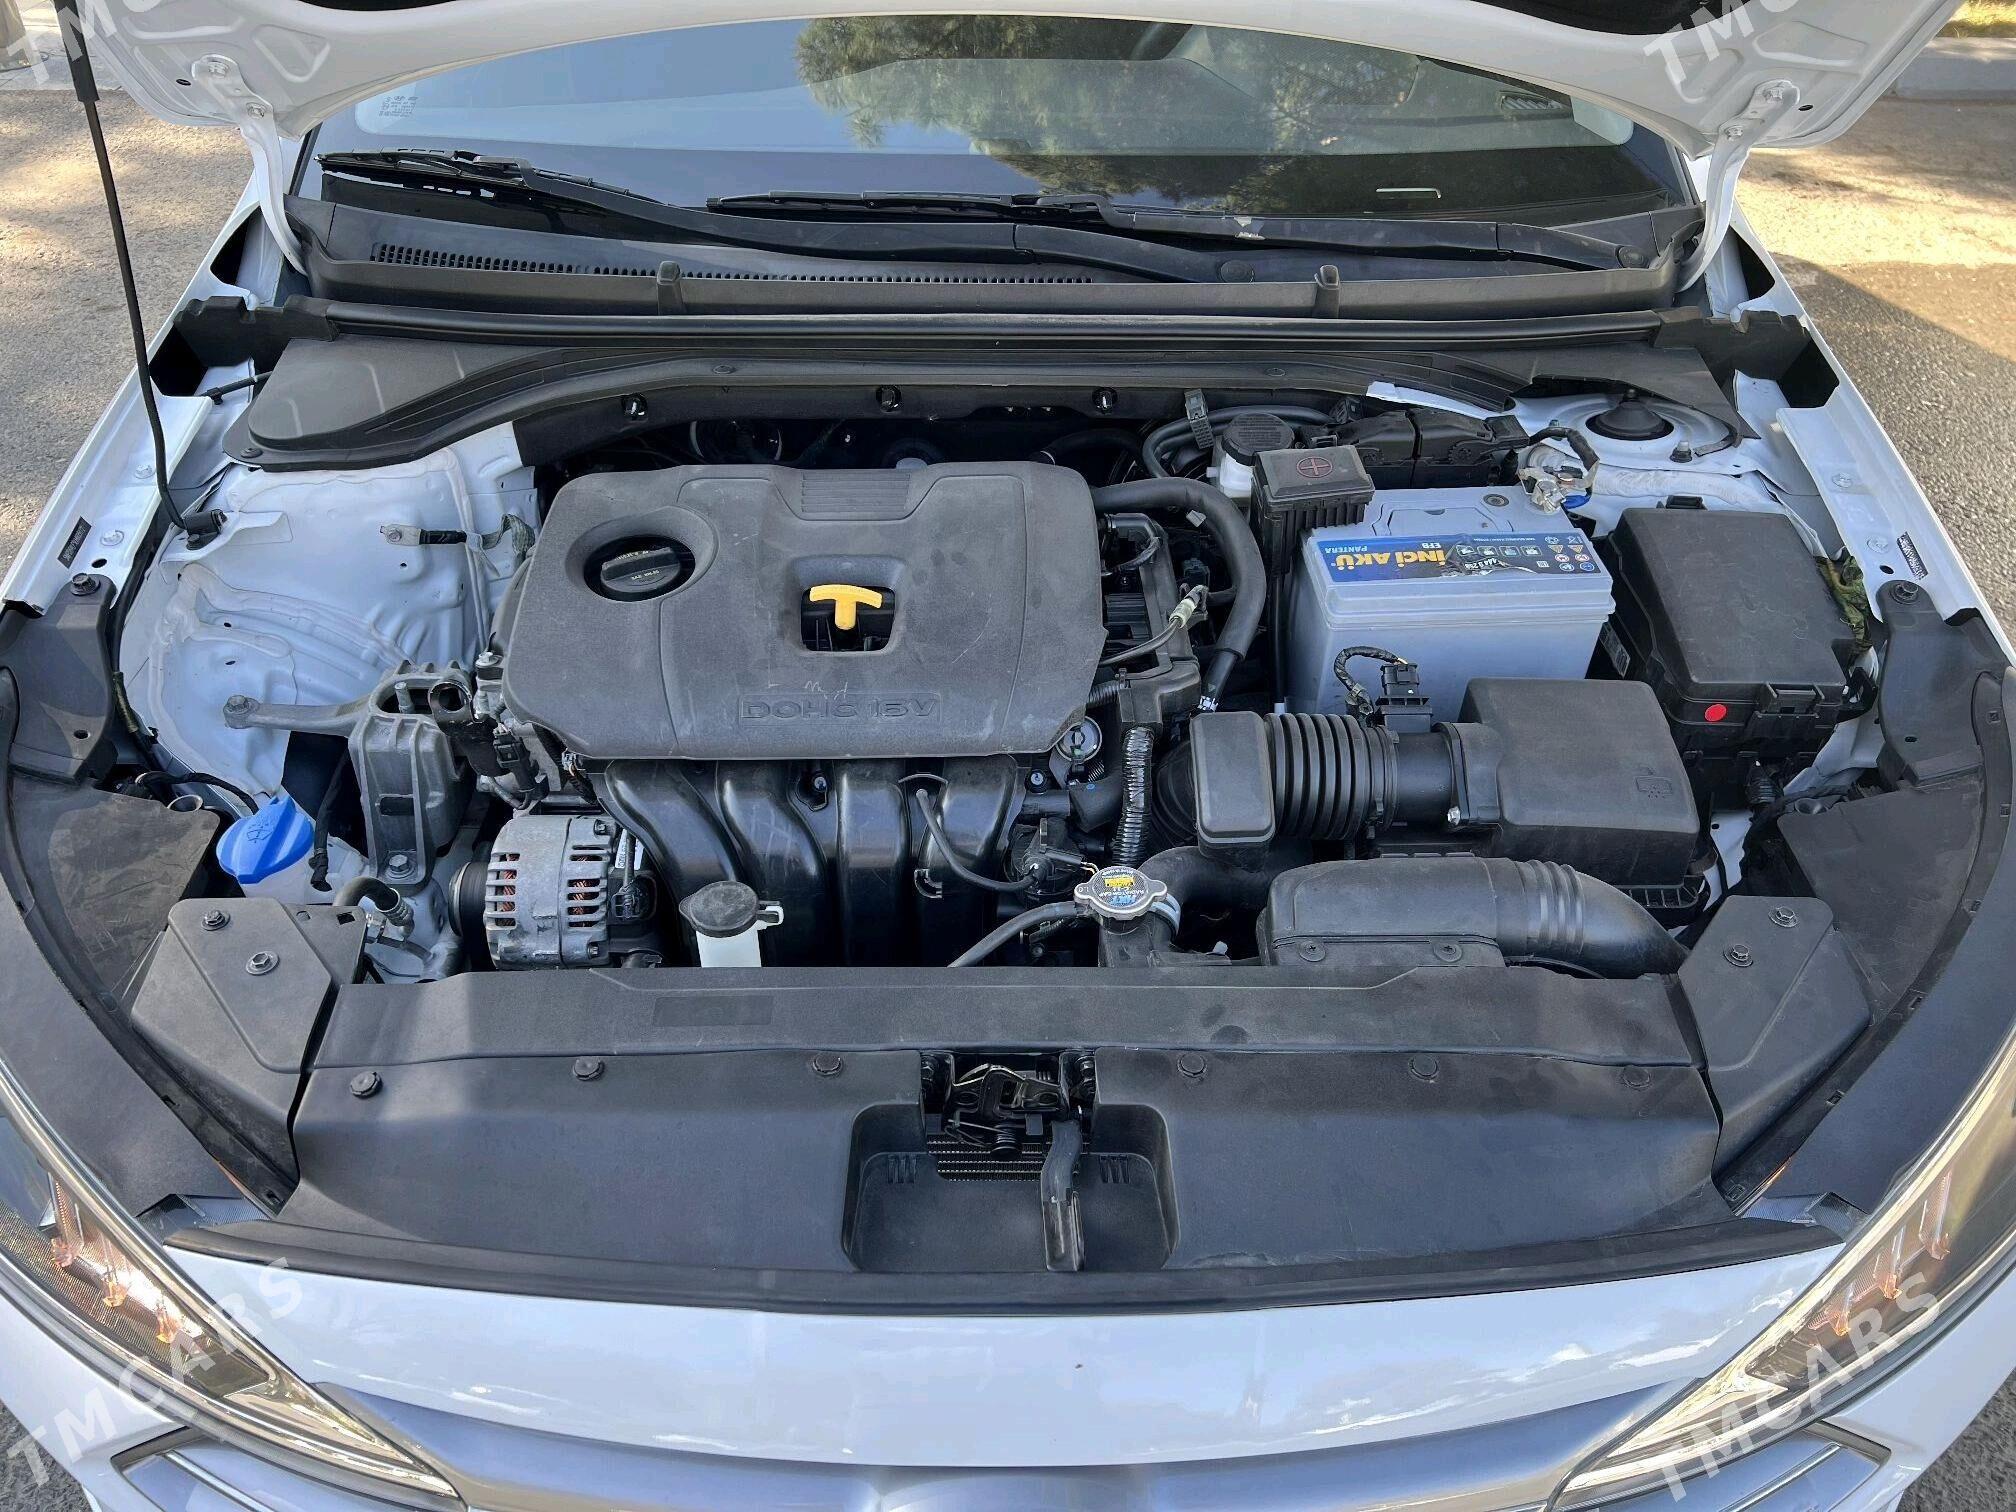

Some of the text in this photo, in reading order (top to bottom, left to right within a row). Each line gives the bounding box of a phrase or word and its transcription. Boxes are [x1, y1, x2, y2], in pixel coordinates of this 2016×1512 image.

[1324, 545, 1368, 553] PANTERA
[1335, 552, 1391, 571] AKÜ
[740, 698, 937, 718] DOHC 16V
